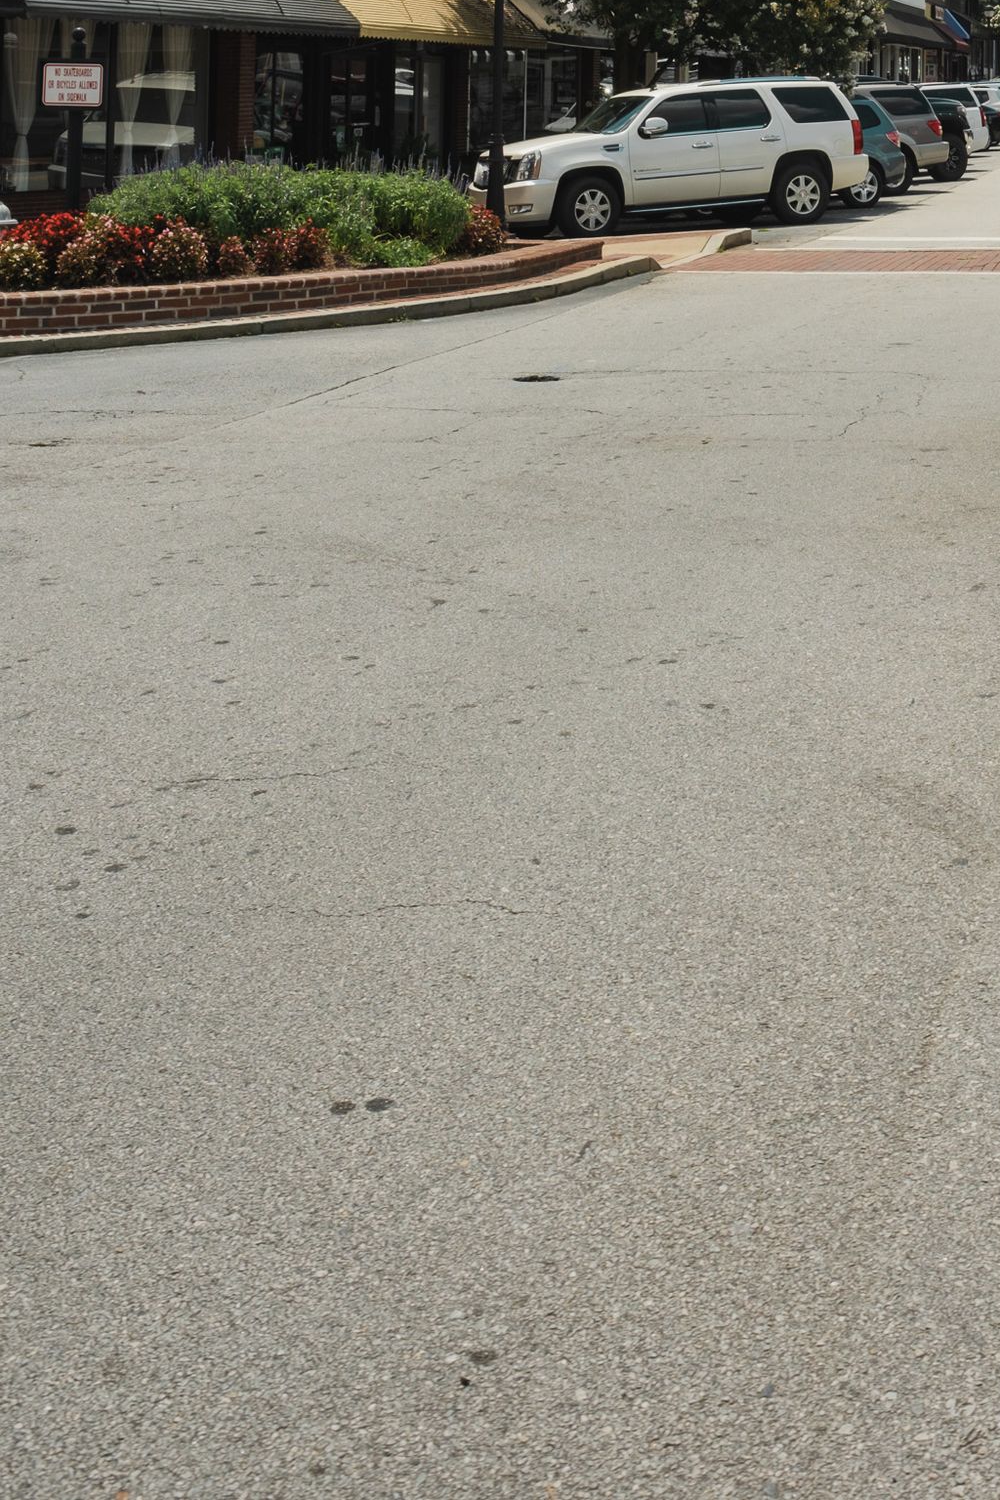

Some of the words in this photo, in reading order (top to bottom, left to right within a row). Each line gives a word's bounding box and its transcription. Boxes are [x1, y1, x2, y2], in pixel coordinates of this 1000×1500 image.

[55, 68, 61, 76] NO
[64, 68, 92, 76] SKATEBOARDS
[48, 80, 54, 88] OR
[57, 80, 77, 89] BICYCLES
[79, 81, 97, 89] ALLOWED
[58, 93, 64, 101] ON
[67, 93, 86, 101] SIDEWALK
